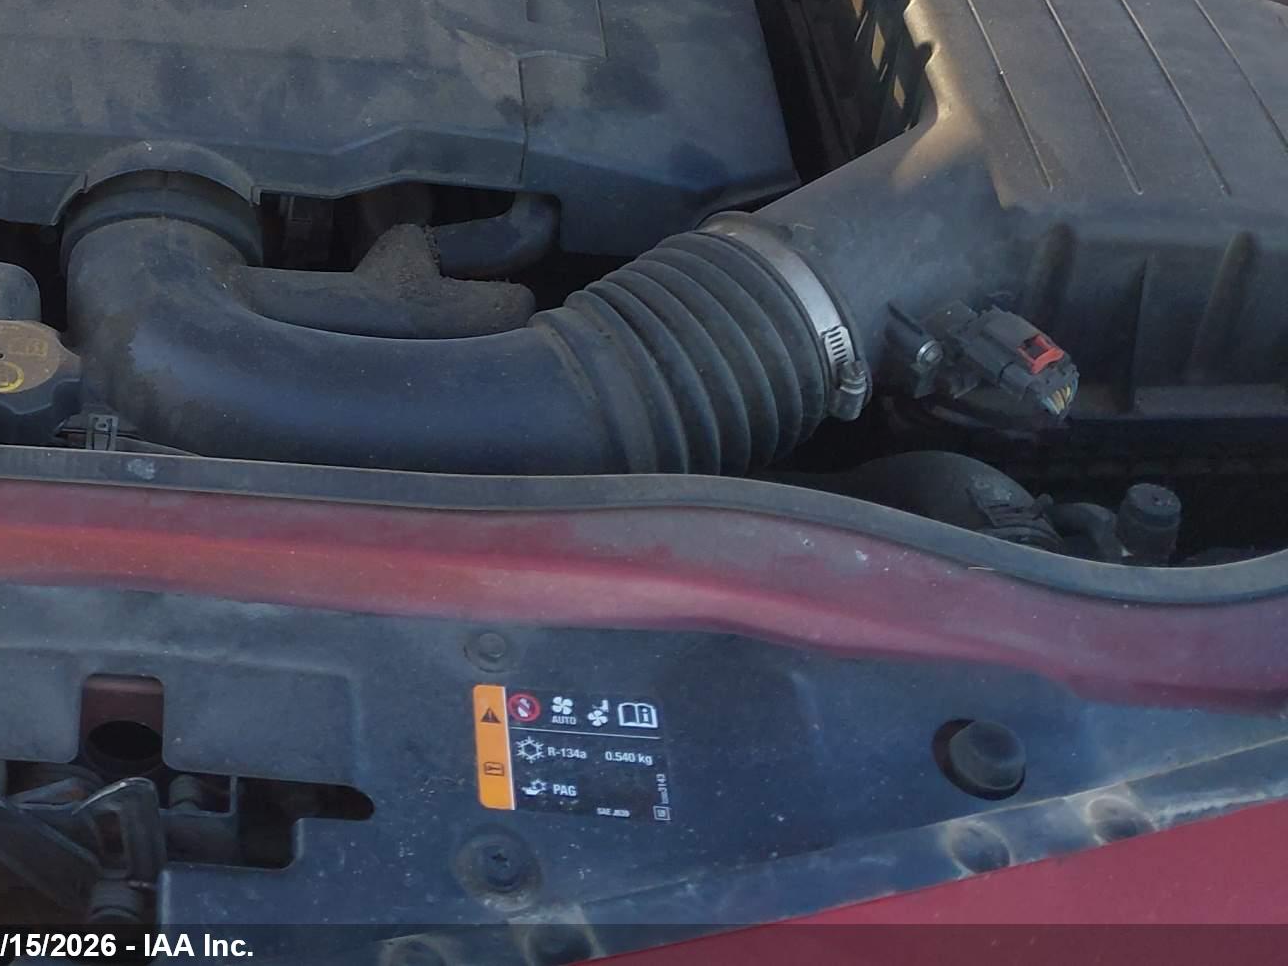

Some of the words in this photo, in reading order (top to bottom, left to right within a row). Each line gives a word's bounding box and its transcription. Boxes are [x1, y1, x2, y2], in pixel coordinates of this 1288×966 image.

[552, 715, 577, 725] AUTO
[547, 747, 587, 759] R-134a
[605, 751, 636, 763] 0.540
[637, 753, 653, 766] kg
[553, 784, 577, 797] PAG
